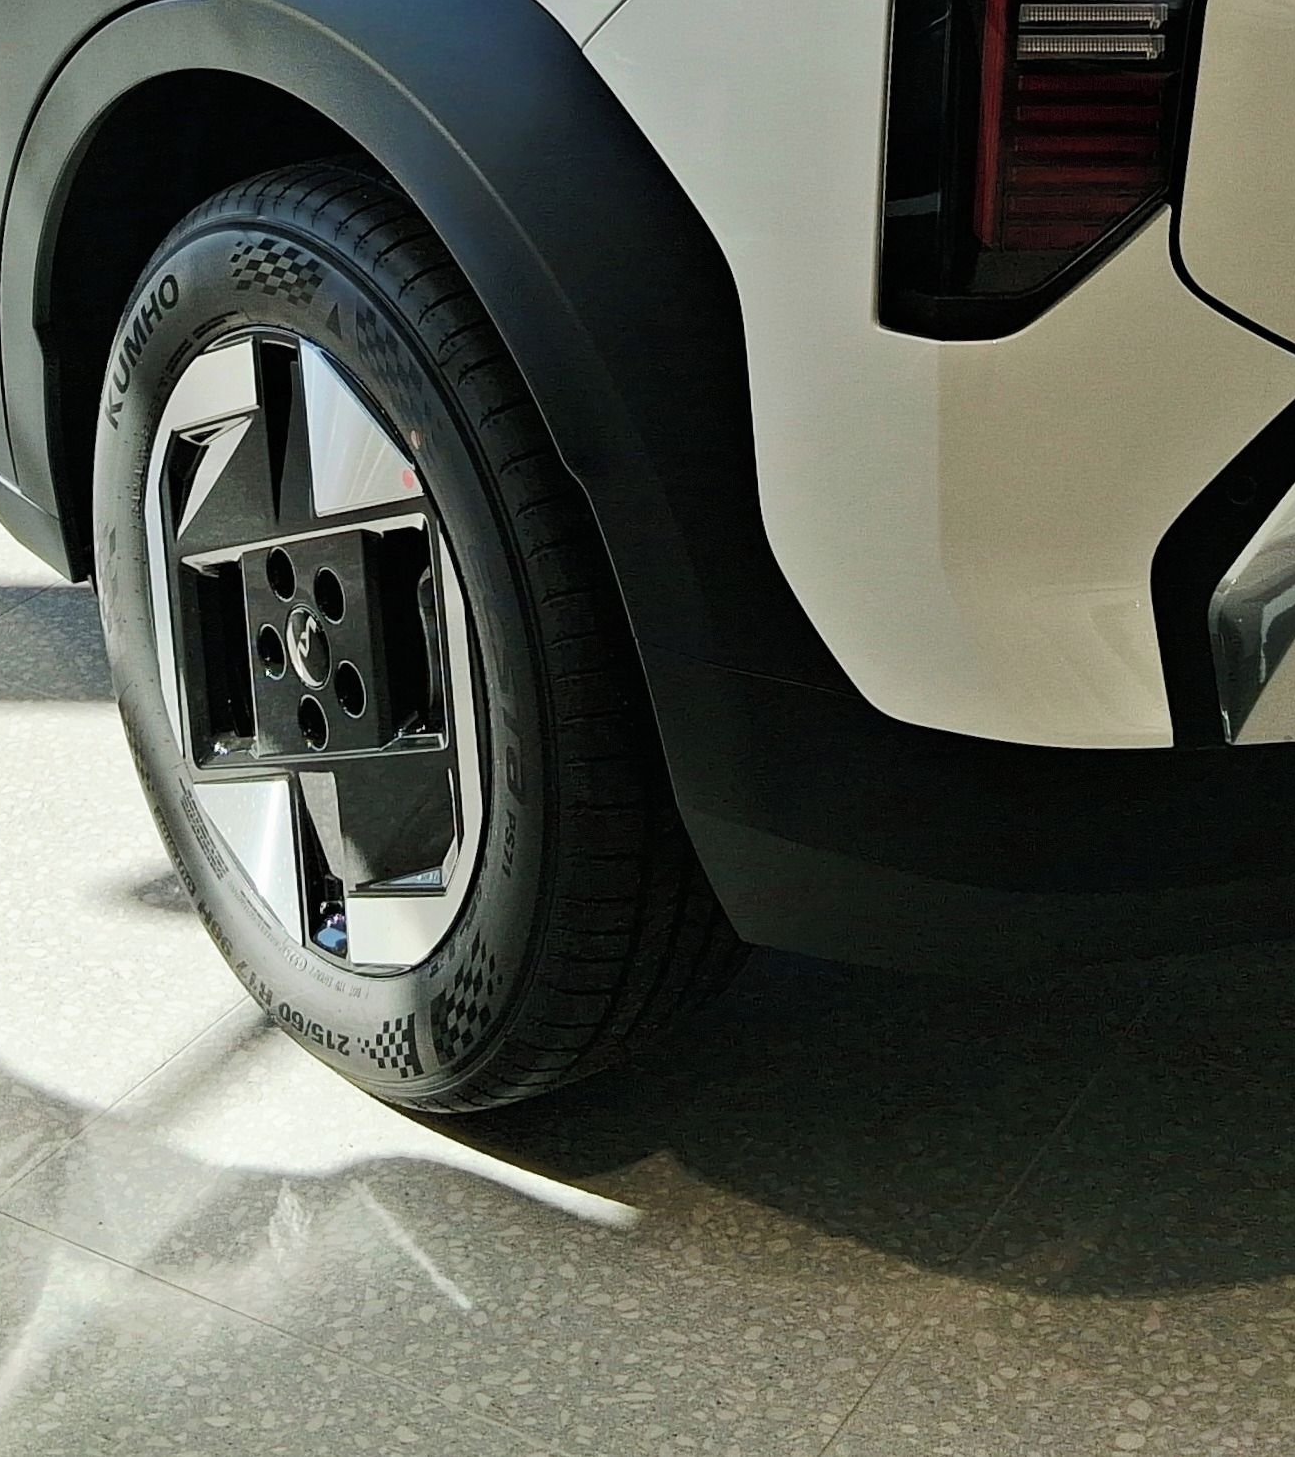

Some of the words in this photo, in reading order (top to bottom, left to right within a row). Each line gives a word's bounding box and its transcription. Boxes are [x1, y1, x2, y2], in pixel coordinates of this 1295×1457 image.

[104, 274, 180, 431] KUMHO
[235, 959, 274, 1007] R17
[278, 1001, 351, 1057] 215/60
